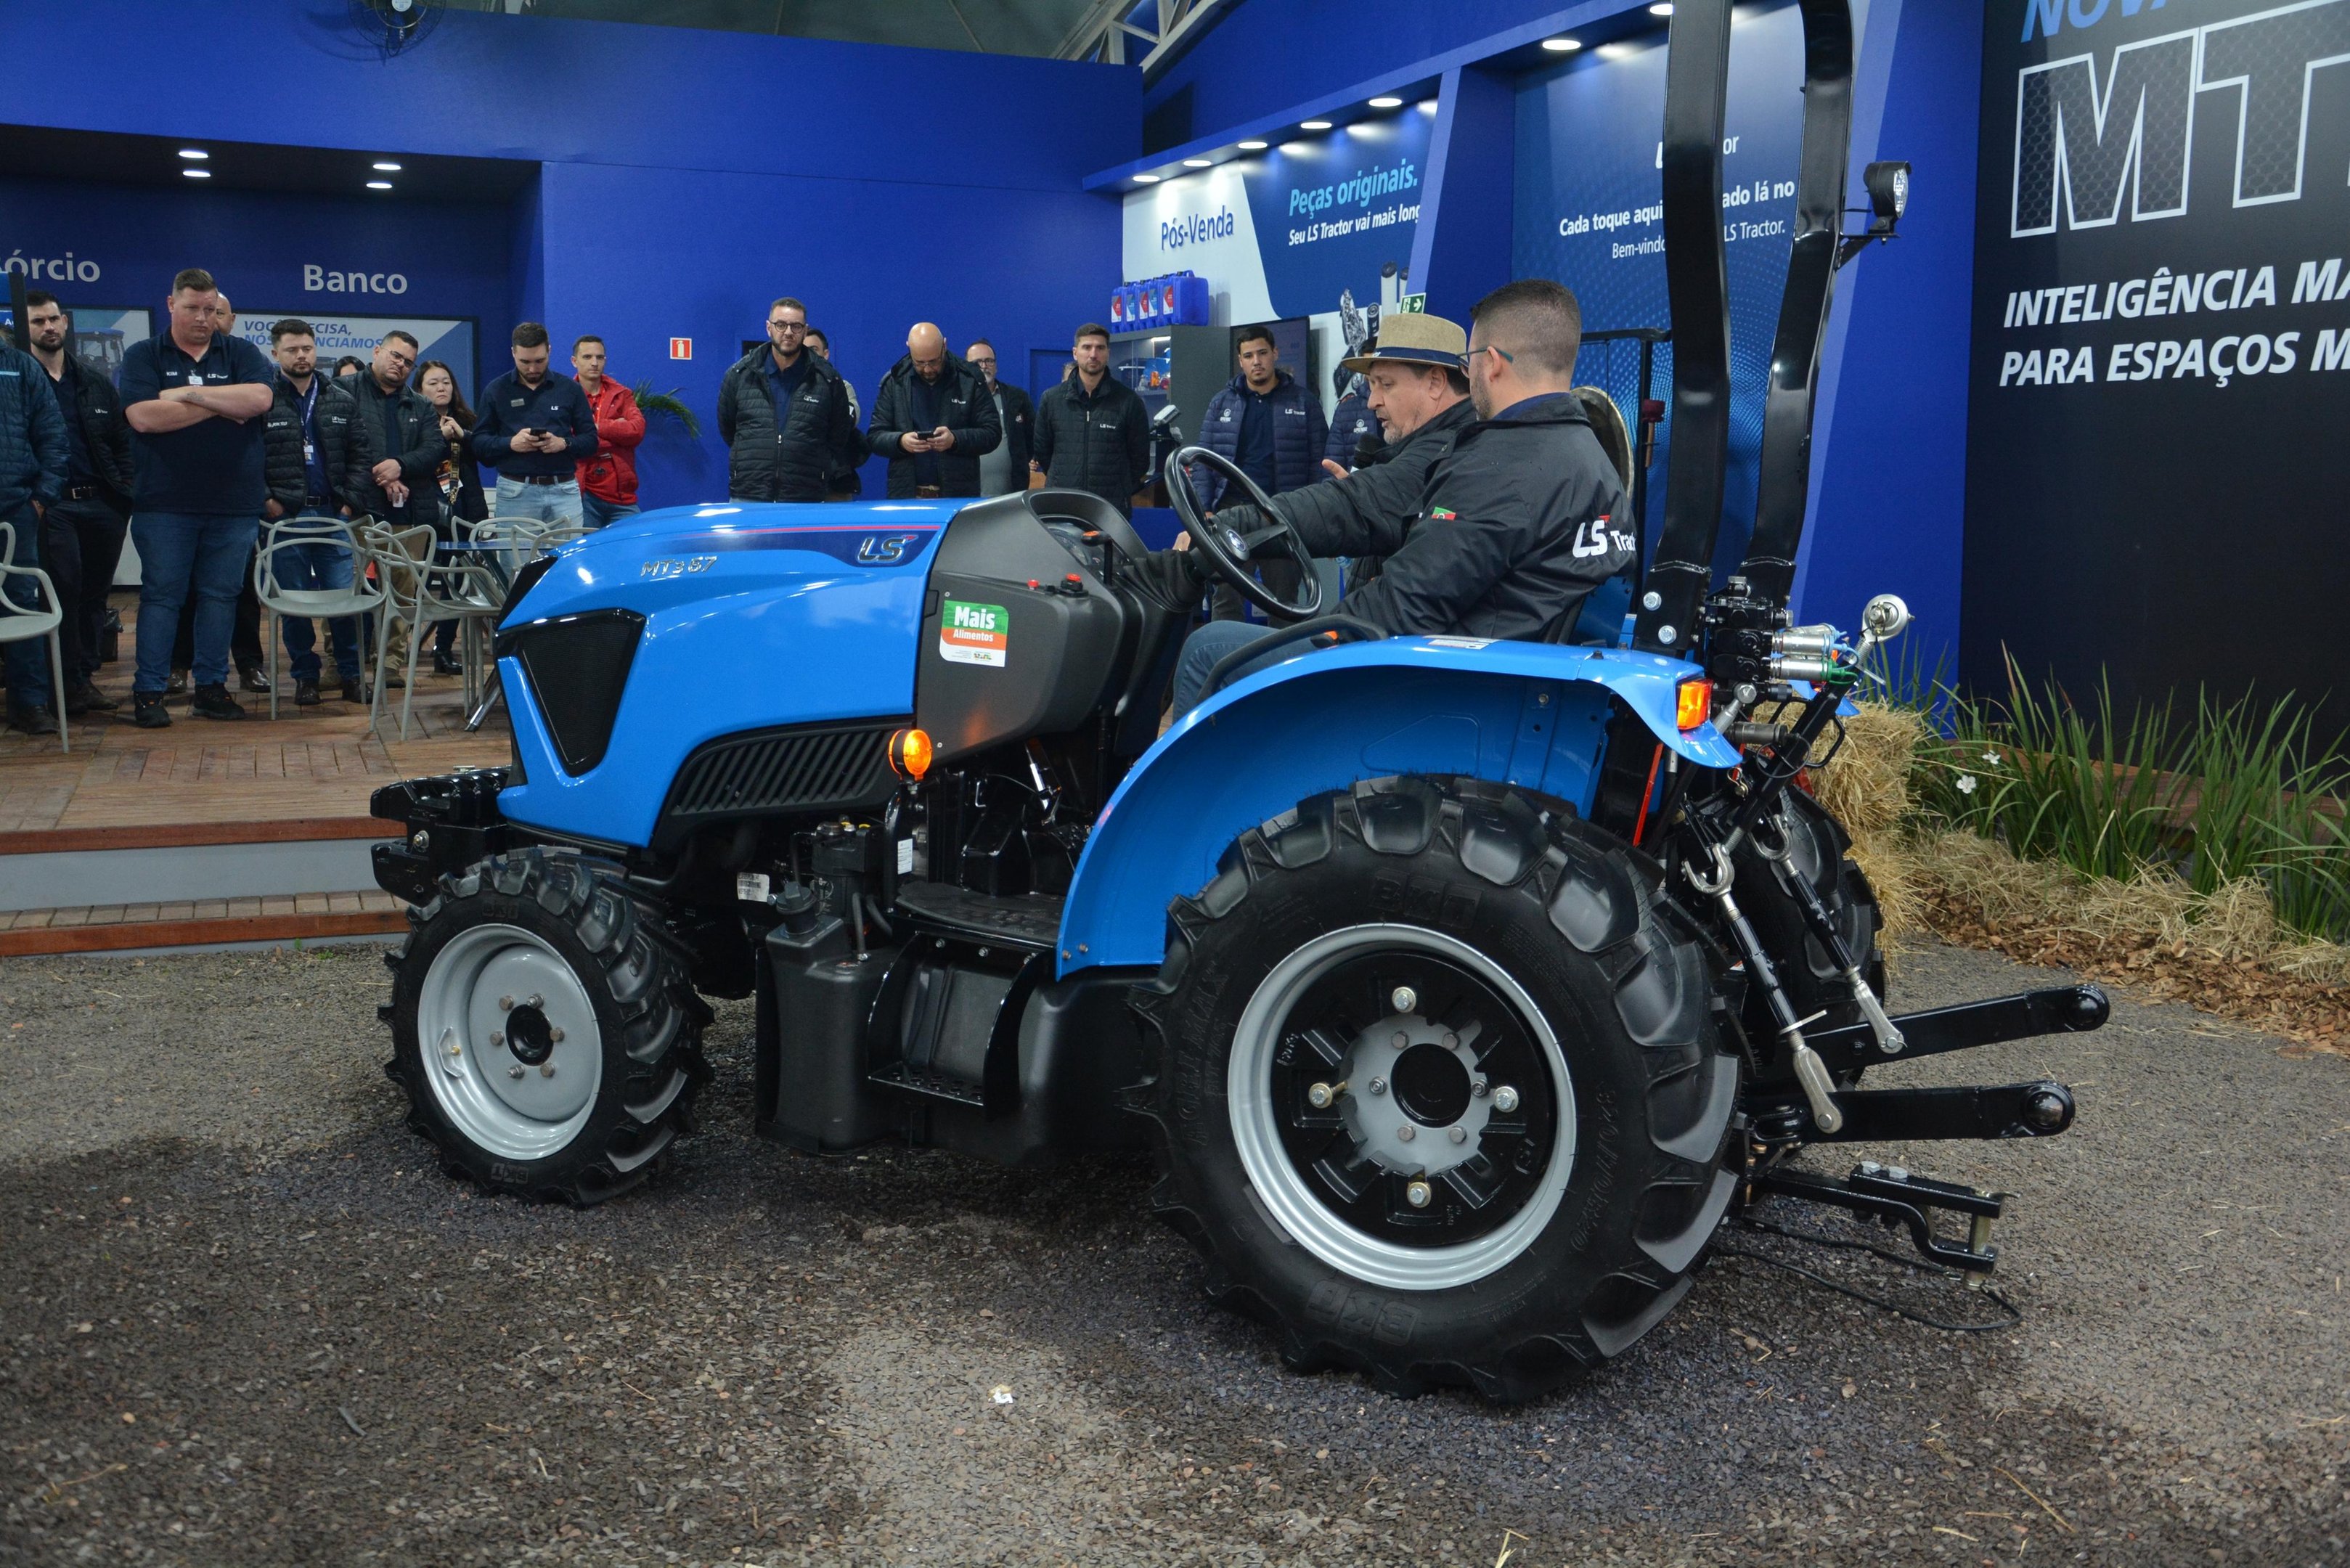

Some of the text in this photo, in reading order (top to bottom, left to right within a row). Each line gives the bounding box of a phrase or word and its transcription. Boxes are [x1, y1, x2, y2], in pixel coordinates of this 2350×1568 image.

[1289, 158, 1418, 219] Peças originais.
[1162, 205, 1233, 250] Pós-Venda
[1289, 229, 1305, 246] Seu
[1307, 224, 1318, 242] LS
[1321, 219, 1354, 239] Tractor
[1355, 211, 1371, 232] vai
[1372, 206, 1396, 228] mais
[1559, 215, 1589, 236] Cada
[1593, 213, 1631, 232] toque
[1633, 200, 1663, 226] aqui
[1755, 181, 1768, 203] lá
[1774, 181, 1795, 199] no
[1724, 224, 1737, 242] LS
[1739, 220, 1785, 239] Tractor.
[303, 264, 408, 294] Banco
[2004, 267, 2275, 327] INTELIGÊNCIA
[1999, 346, 2094, 387] PARA
[2106, 332, 2300, 388] ESPAÇOS
[854, 537, 909, 564] LS
[1572, 520, 1608, 558] LS
[953, 629, 994, 642] Alimentos
[954, 605, 995, 630] Mais
